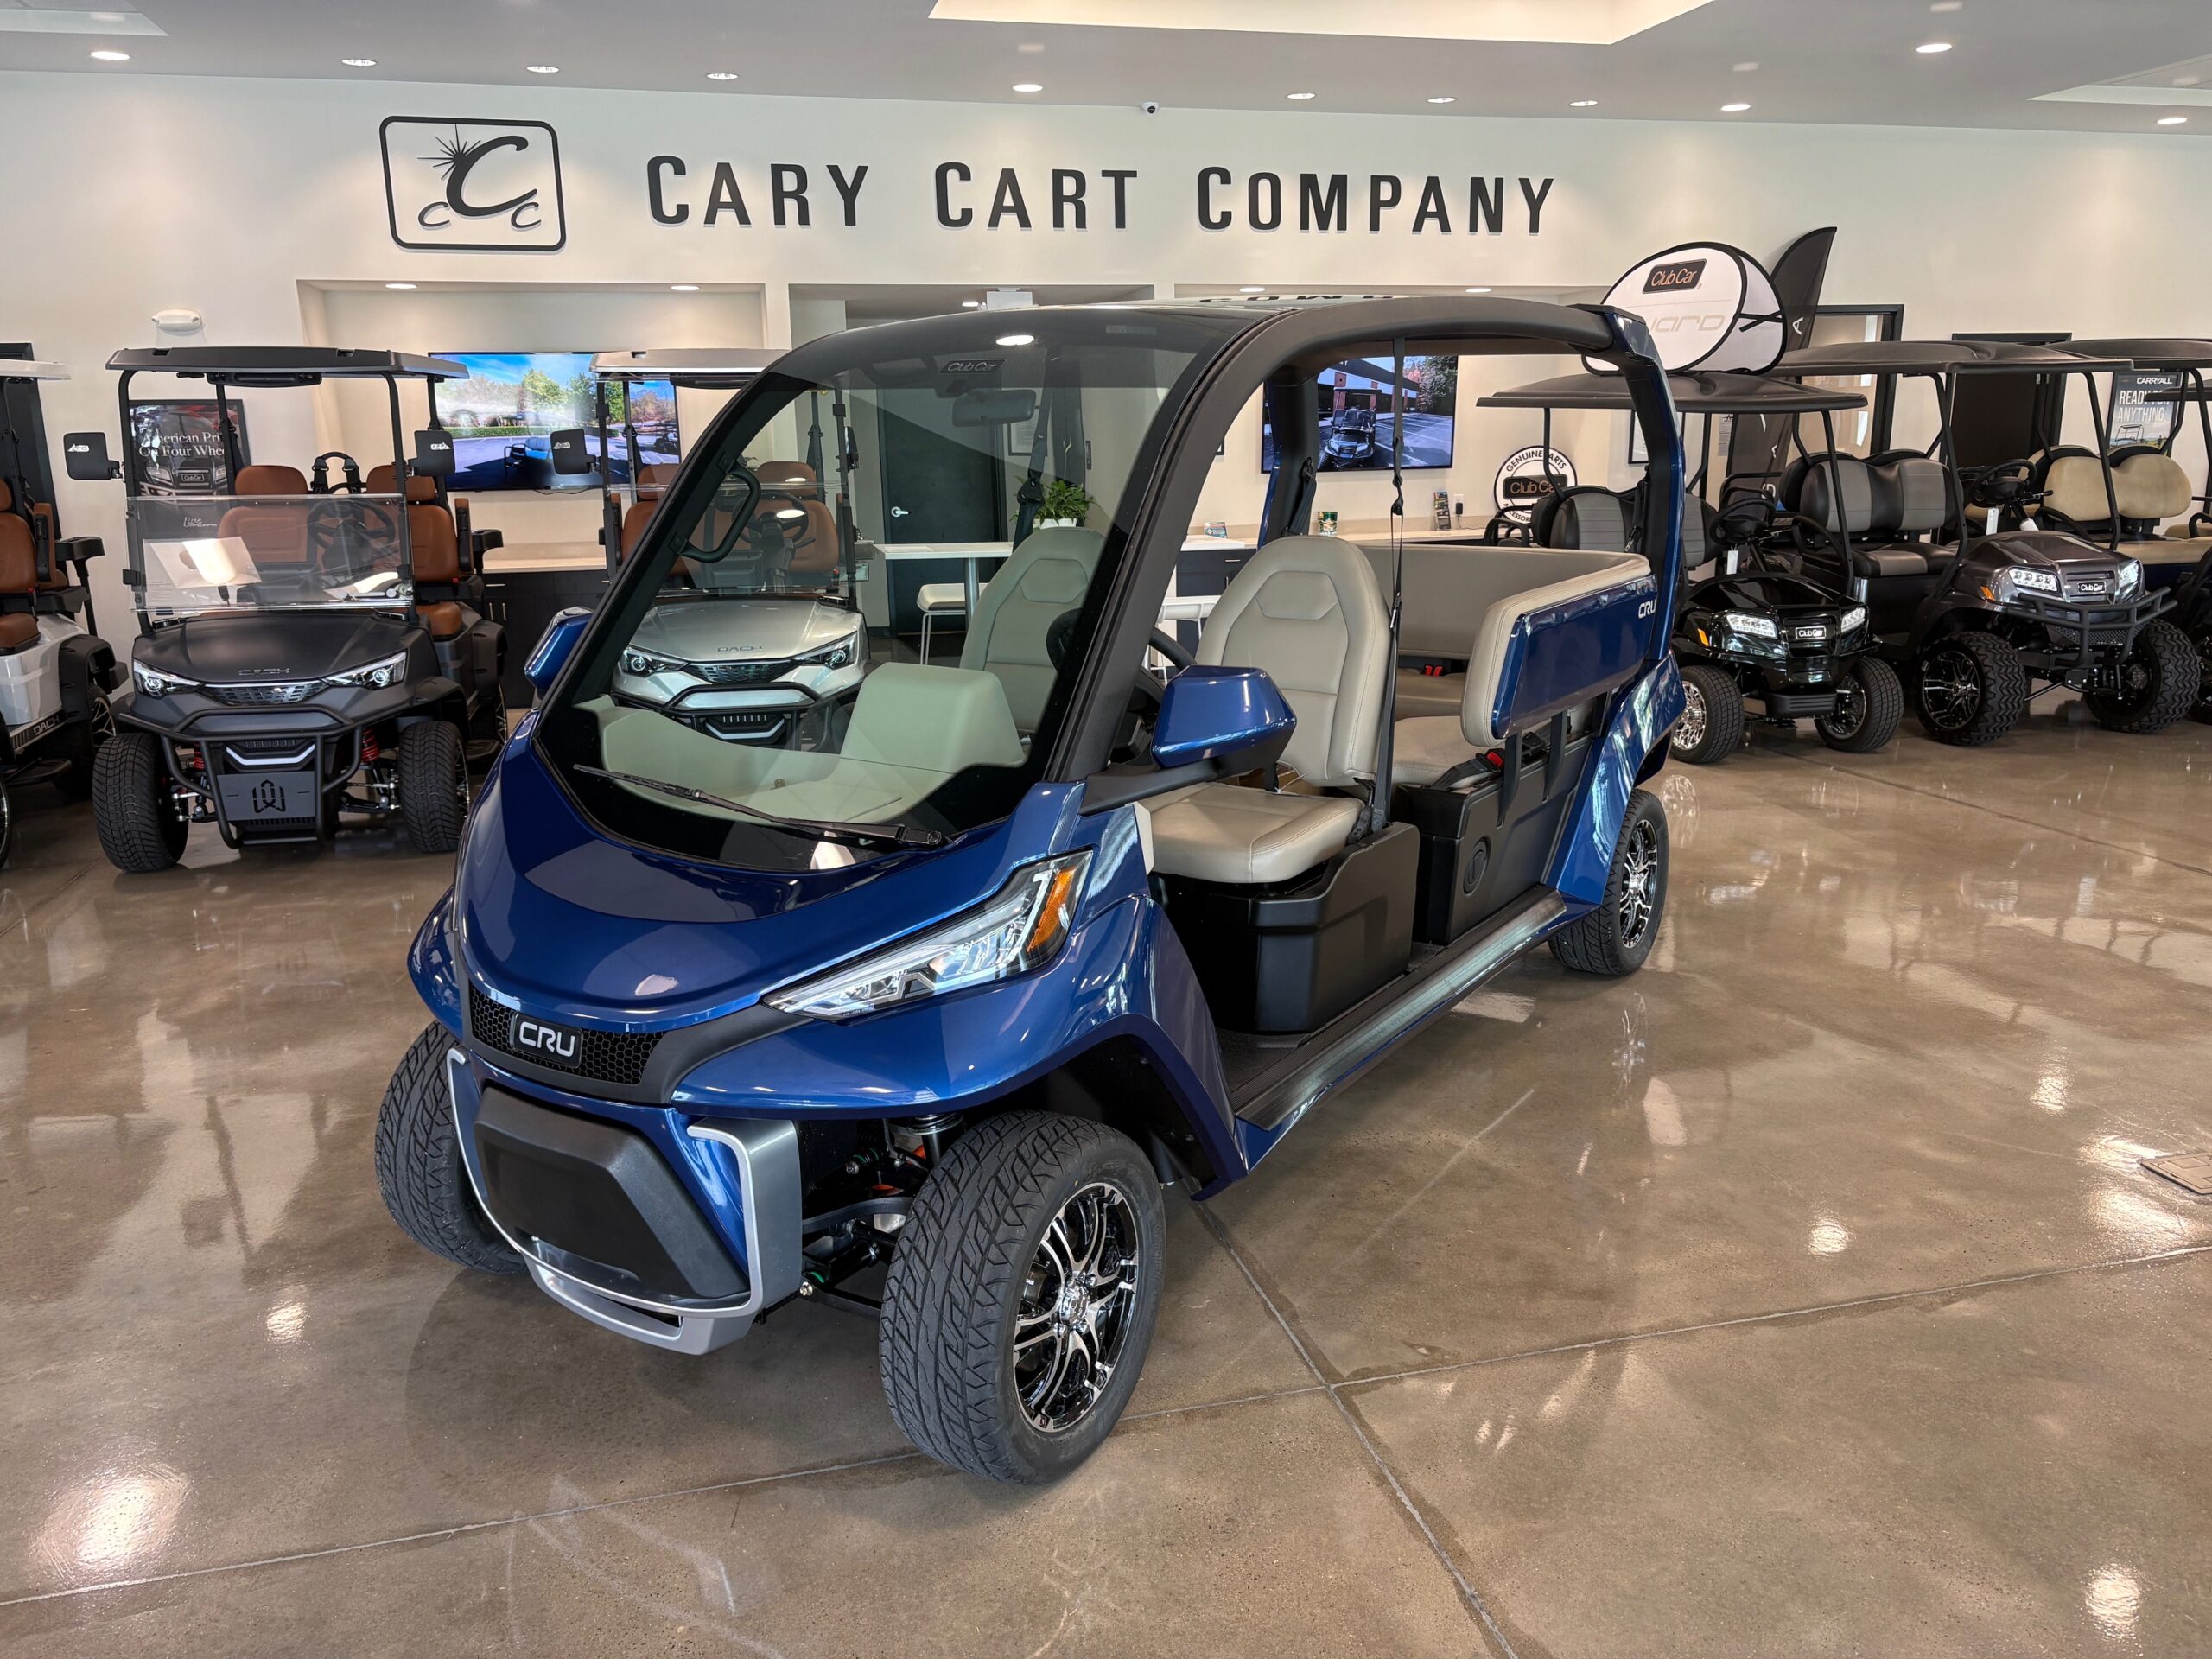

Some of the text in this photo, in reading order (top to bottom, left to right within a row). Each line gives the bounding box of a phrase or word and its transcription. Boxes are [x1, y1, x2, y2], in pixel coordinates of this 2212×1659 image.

[646, 156, 1554, 233] CARY CART COMPANY
[1651, 268, 1697, 286] Club Car
[162, 445, 192, 457] Four
[1506, 450, 1567, 472] GENUINE ARTS
[1510, 480, 1555, 493] Club Ca
[1638, 599, 1657, 619] CRU
[33, 715, 60, 735] DACH
[519, 1021, 575, 1057] CRU
